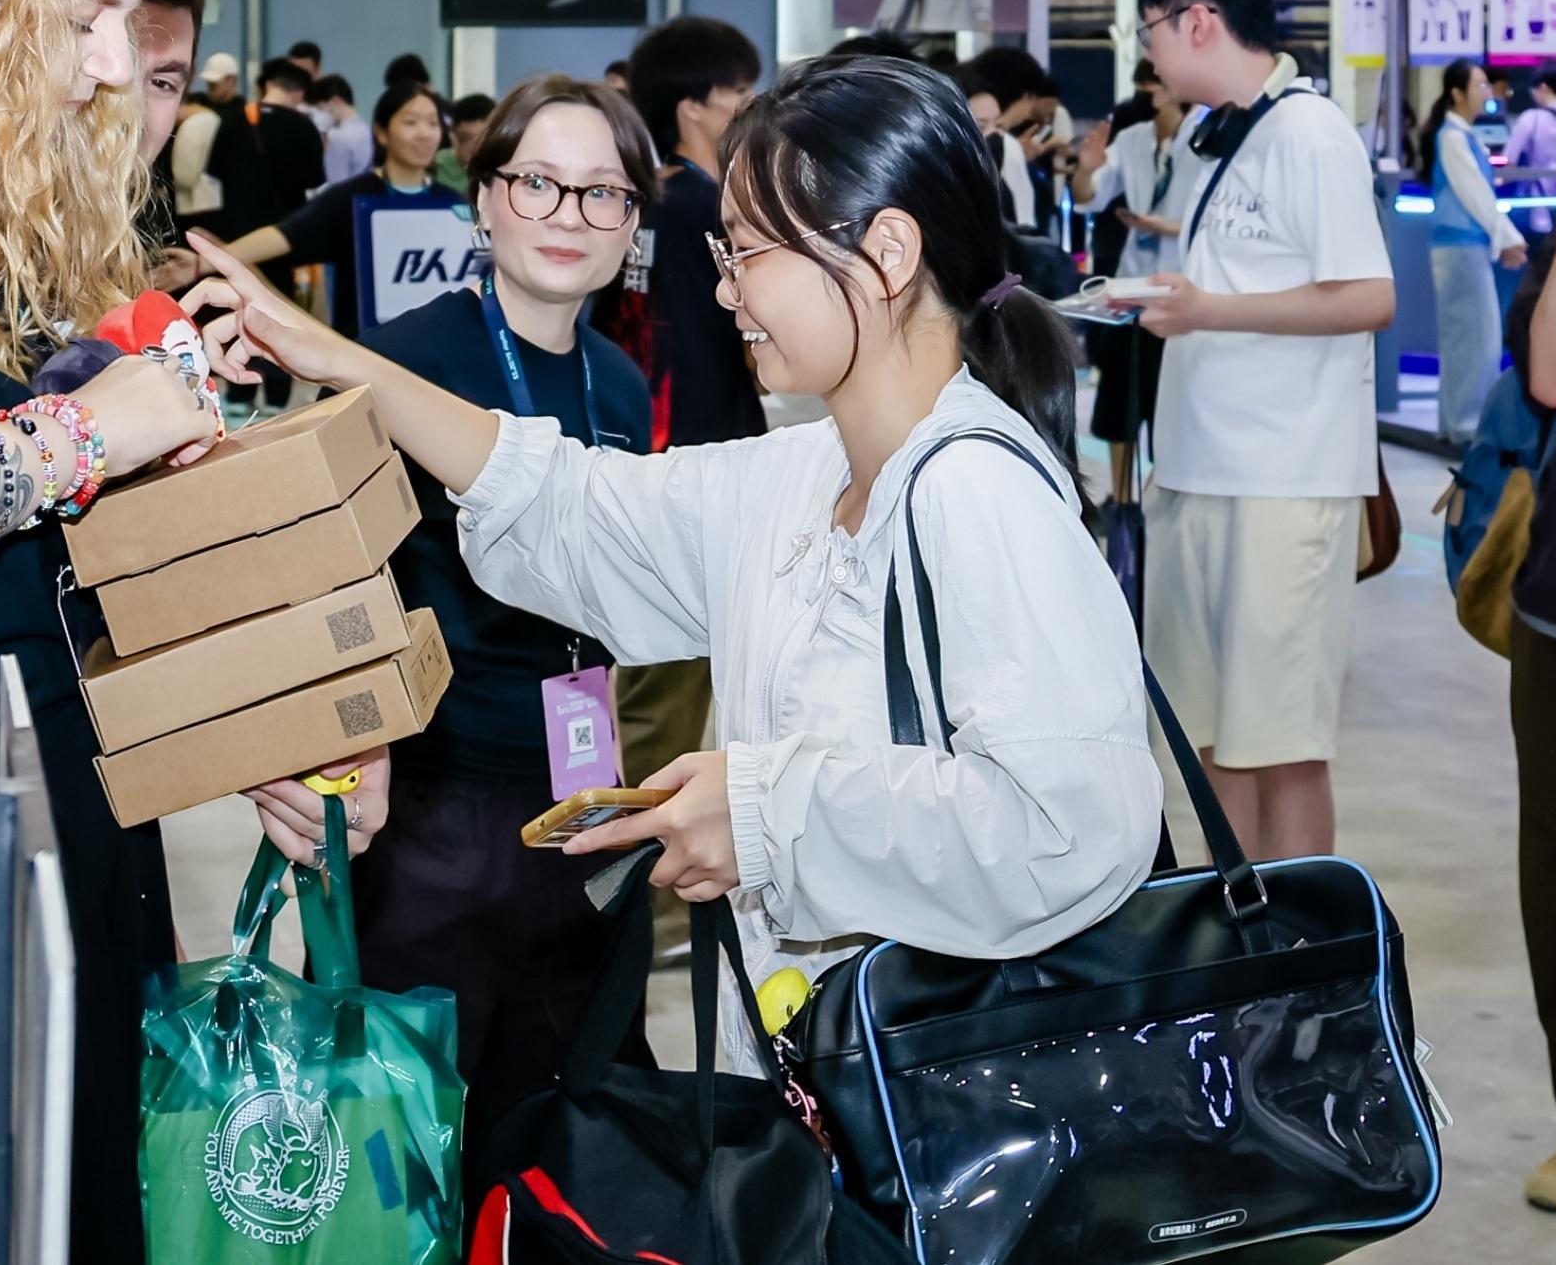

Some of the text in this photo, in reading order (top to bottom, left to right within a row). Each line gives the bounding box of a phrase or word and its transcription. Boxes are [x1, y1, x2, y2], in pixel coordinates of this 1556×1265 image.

[203, 1131, 221, 1166] YOU
[204, 1167, 225, 1203] AND
[218, 1201, 241, 1232] ME,
[242, 1218, 320, 1245] TOGETHER
